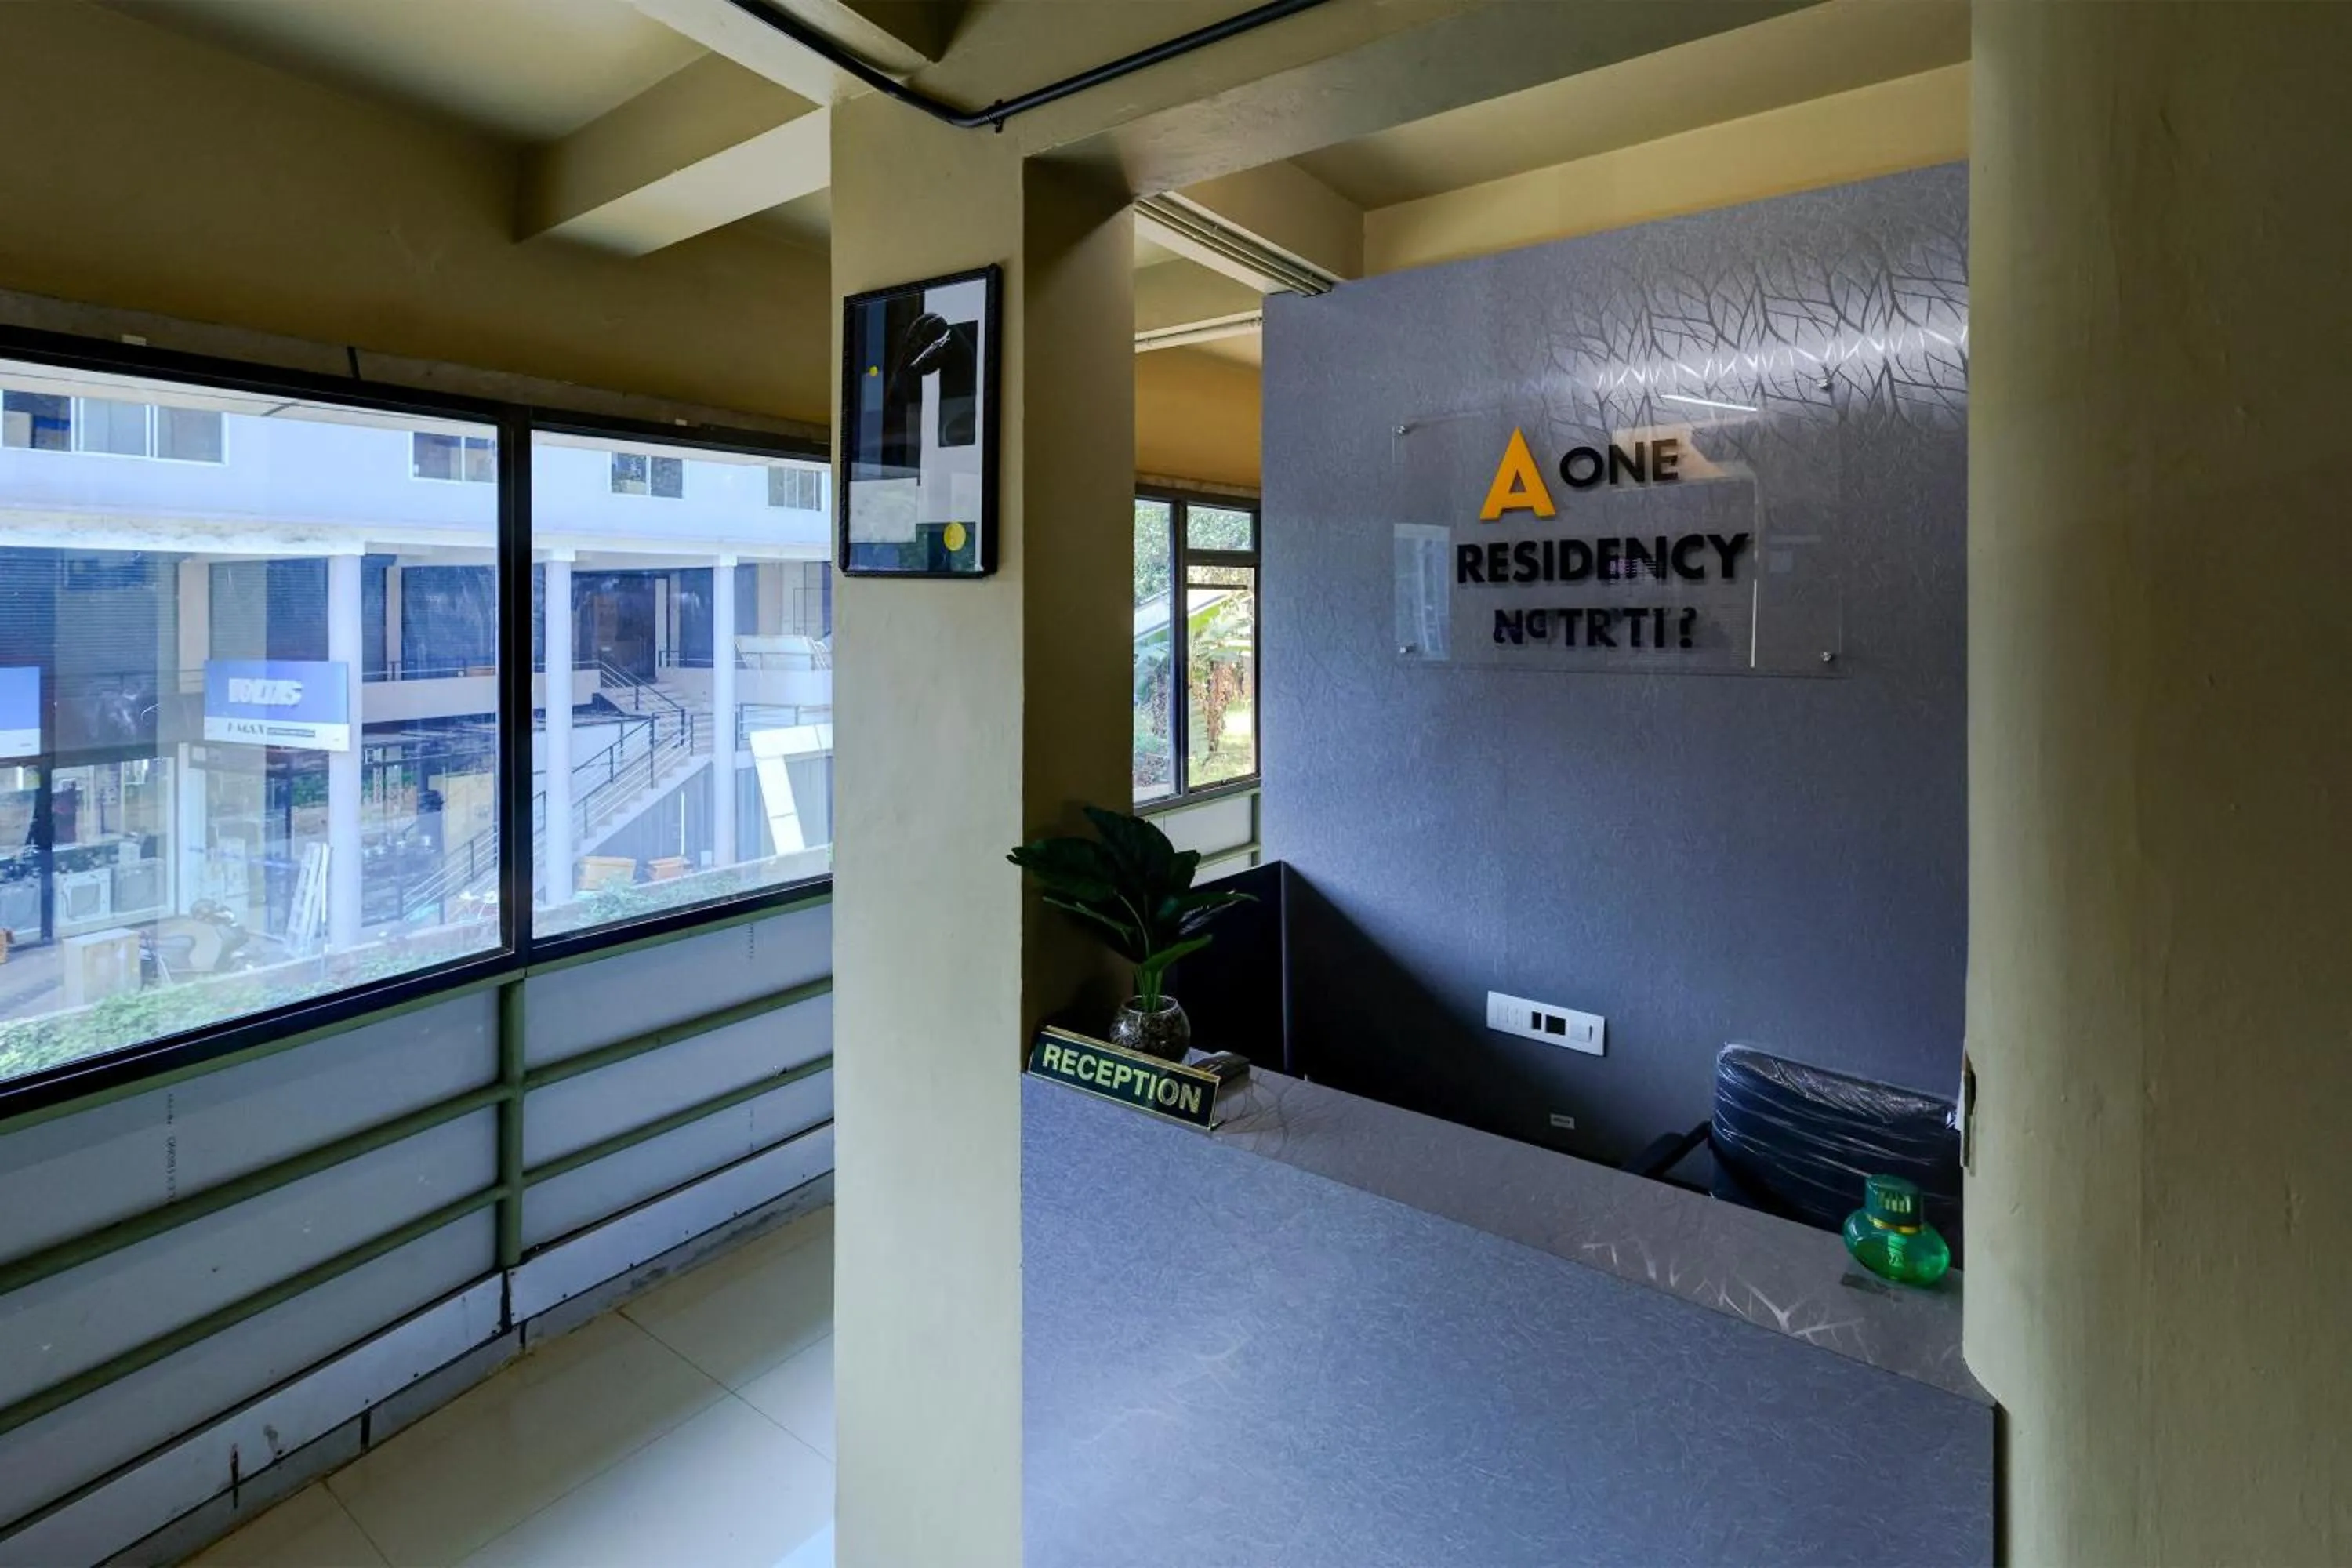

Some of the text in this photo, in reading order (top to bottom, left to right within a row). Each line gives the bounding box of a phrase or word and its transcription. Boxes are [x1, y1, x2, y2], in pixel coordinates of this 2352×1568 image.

[1480, 426, 1679, 521] A ONE
[1457, 533, 1749, 584] RESIDENCY
[1042, 1043, 1202, 1114] RECEPTION
